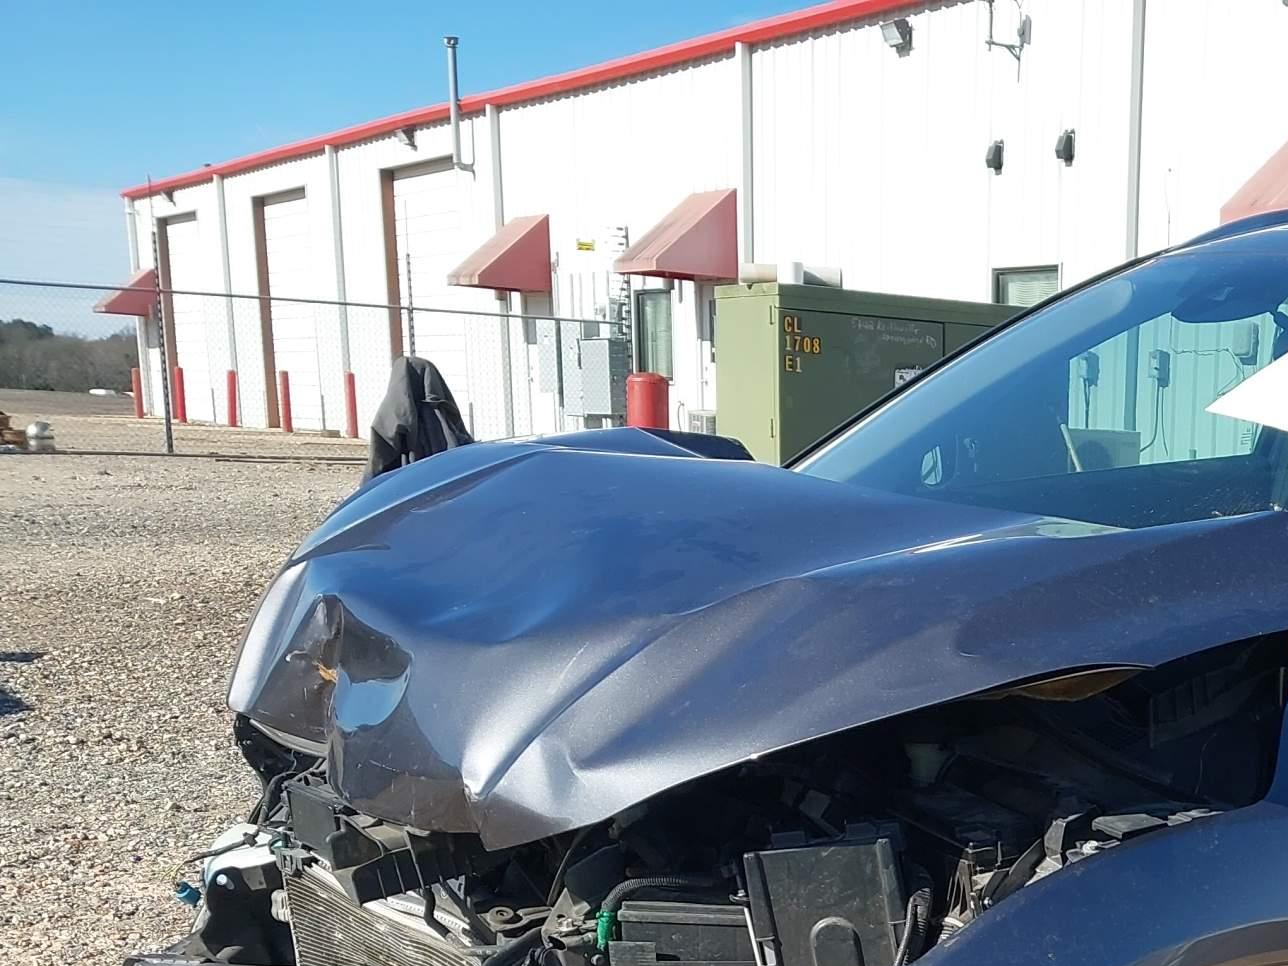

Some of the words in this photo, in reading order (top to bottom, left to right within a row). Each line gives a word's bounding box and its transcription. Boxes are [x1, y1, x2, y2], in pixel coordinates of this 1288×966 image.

[784, 316, 802, 333] CL
[785, 335, 820, 354] 1708
[785, 355, 802, 373] E1
